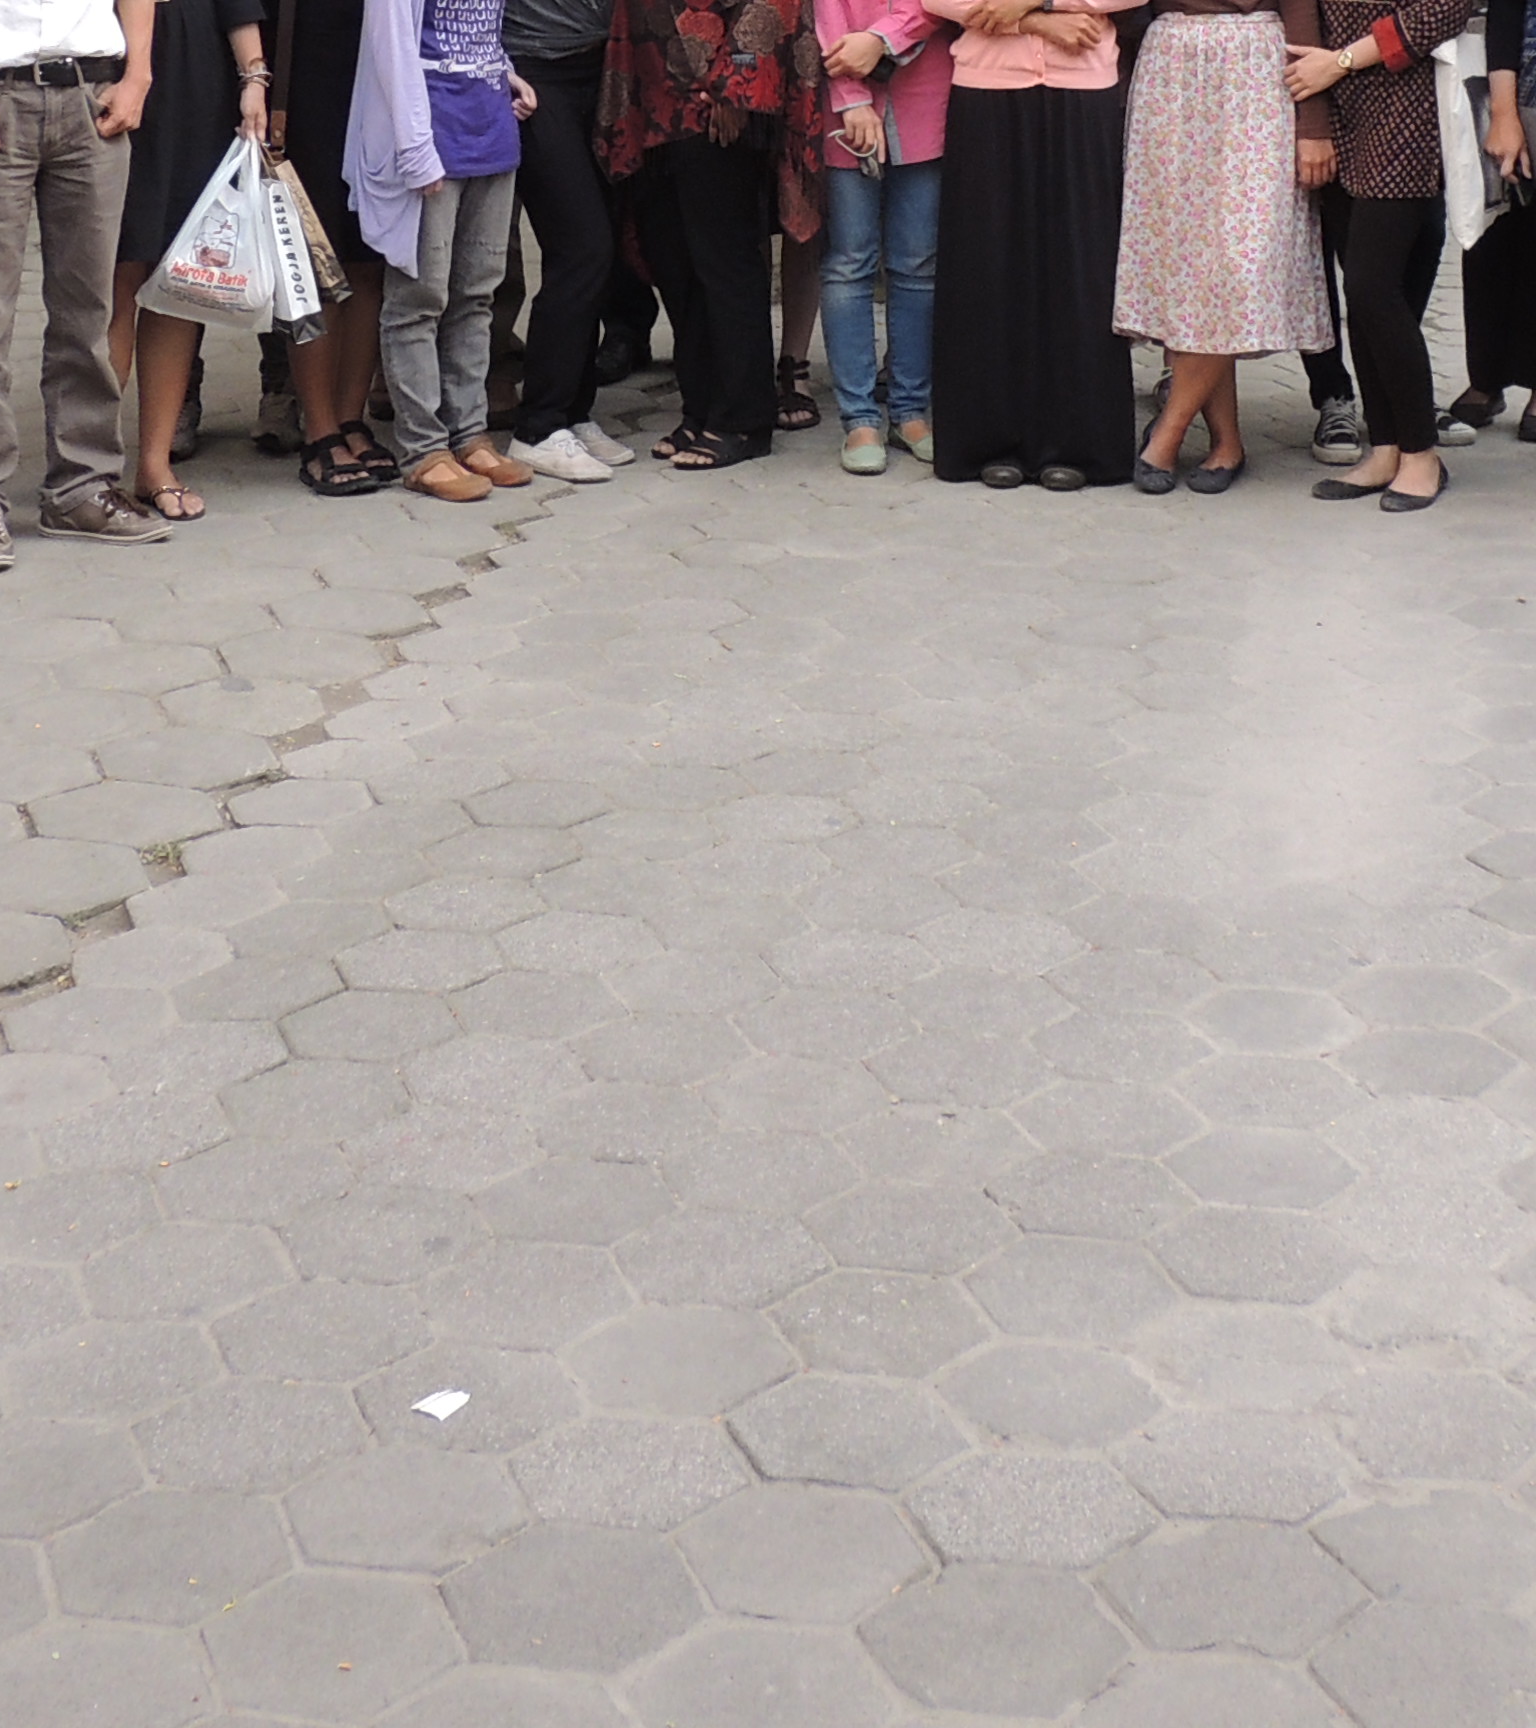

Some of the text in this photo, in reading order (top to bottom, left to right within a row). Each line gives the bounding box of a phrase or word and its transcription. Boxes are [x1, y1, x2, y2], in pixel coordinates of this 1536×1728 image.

[272, 194, 295, 246] KEREN
[217, 272, 248, 287] Batik
[285, 252, 308, 304] JOGJA
